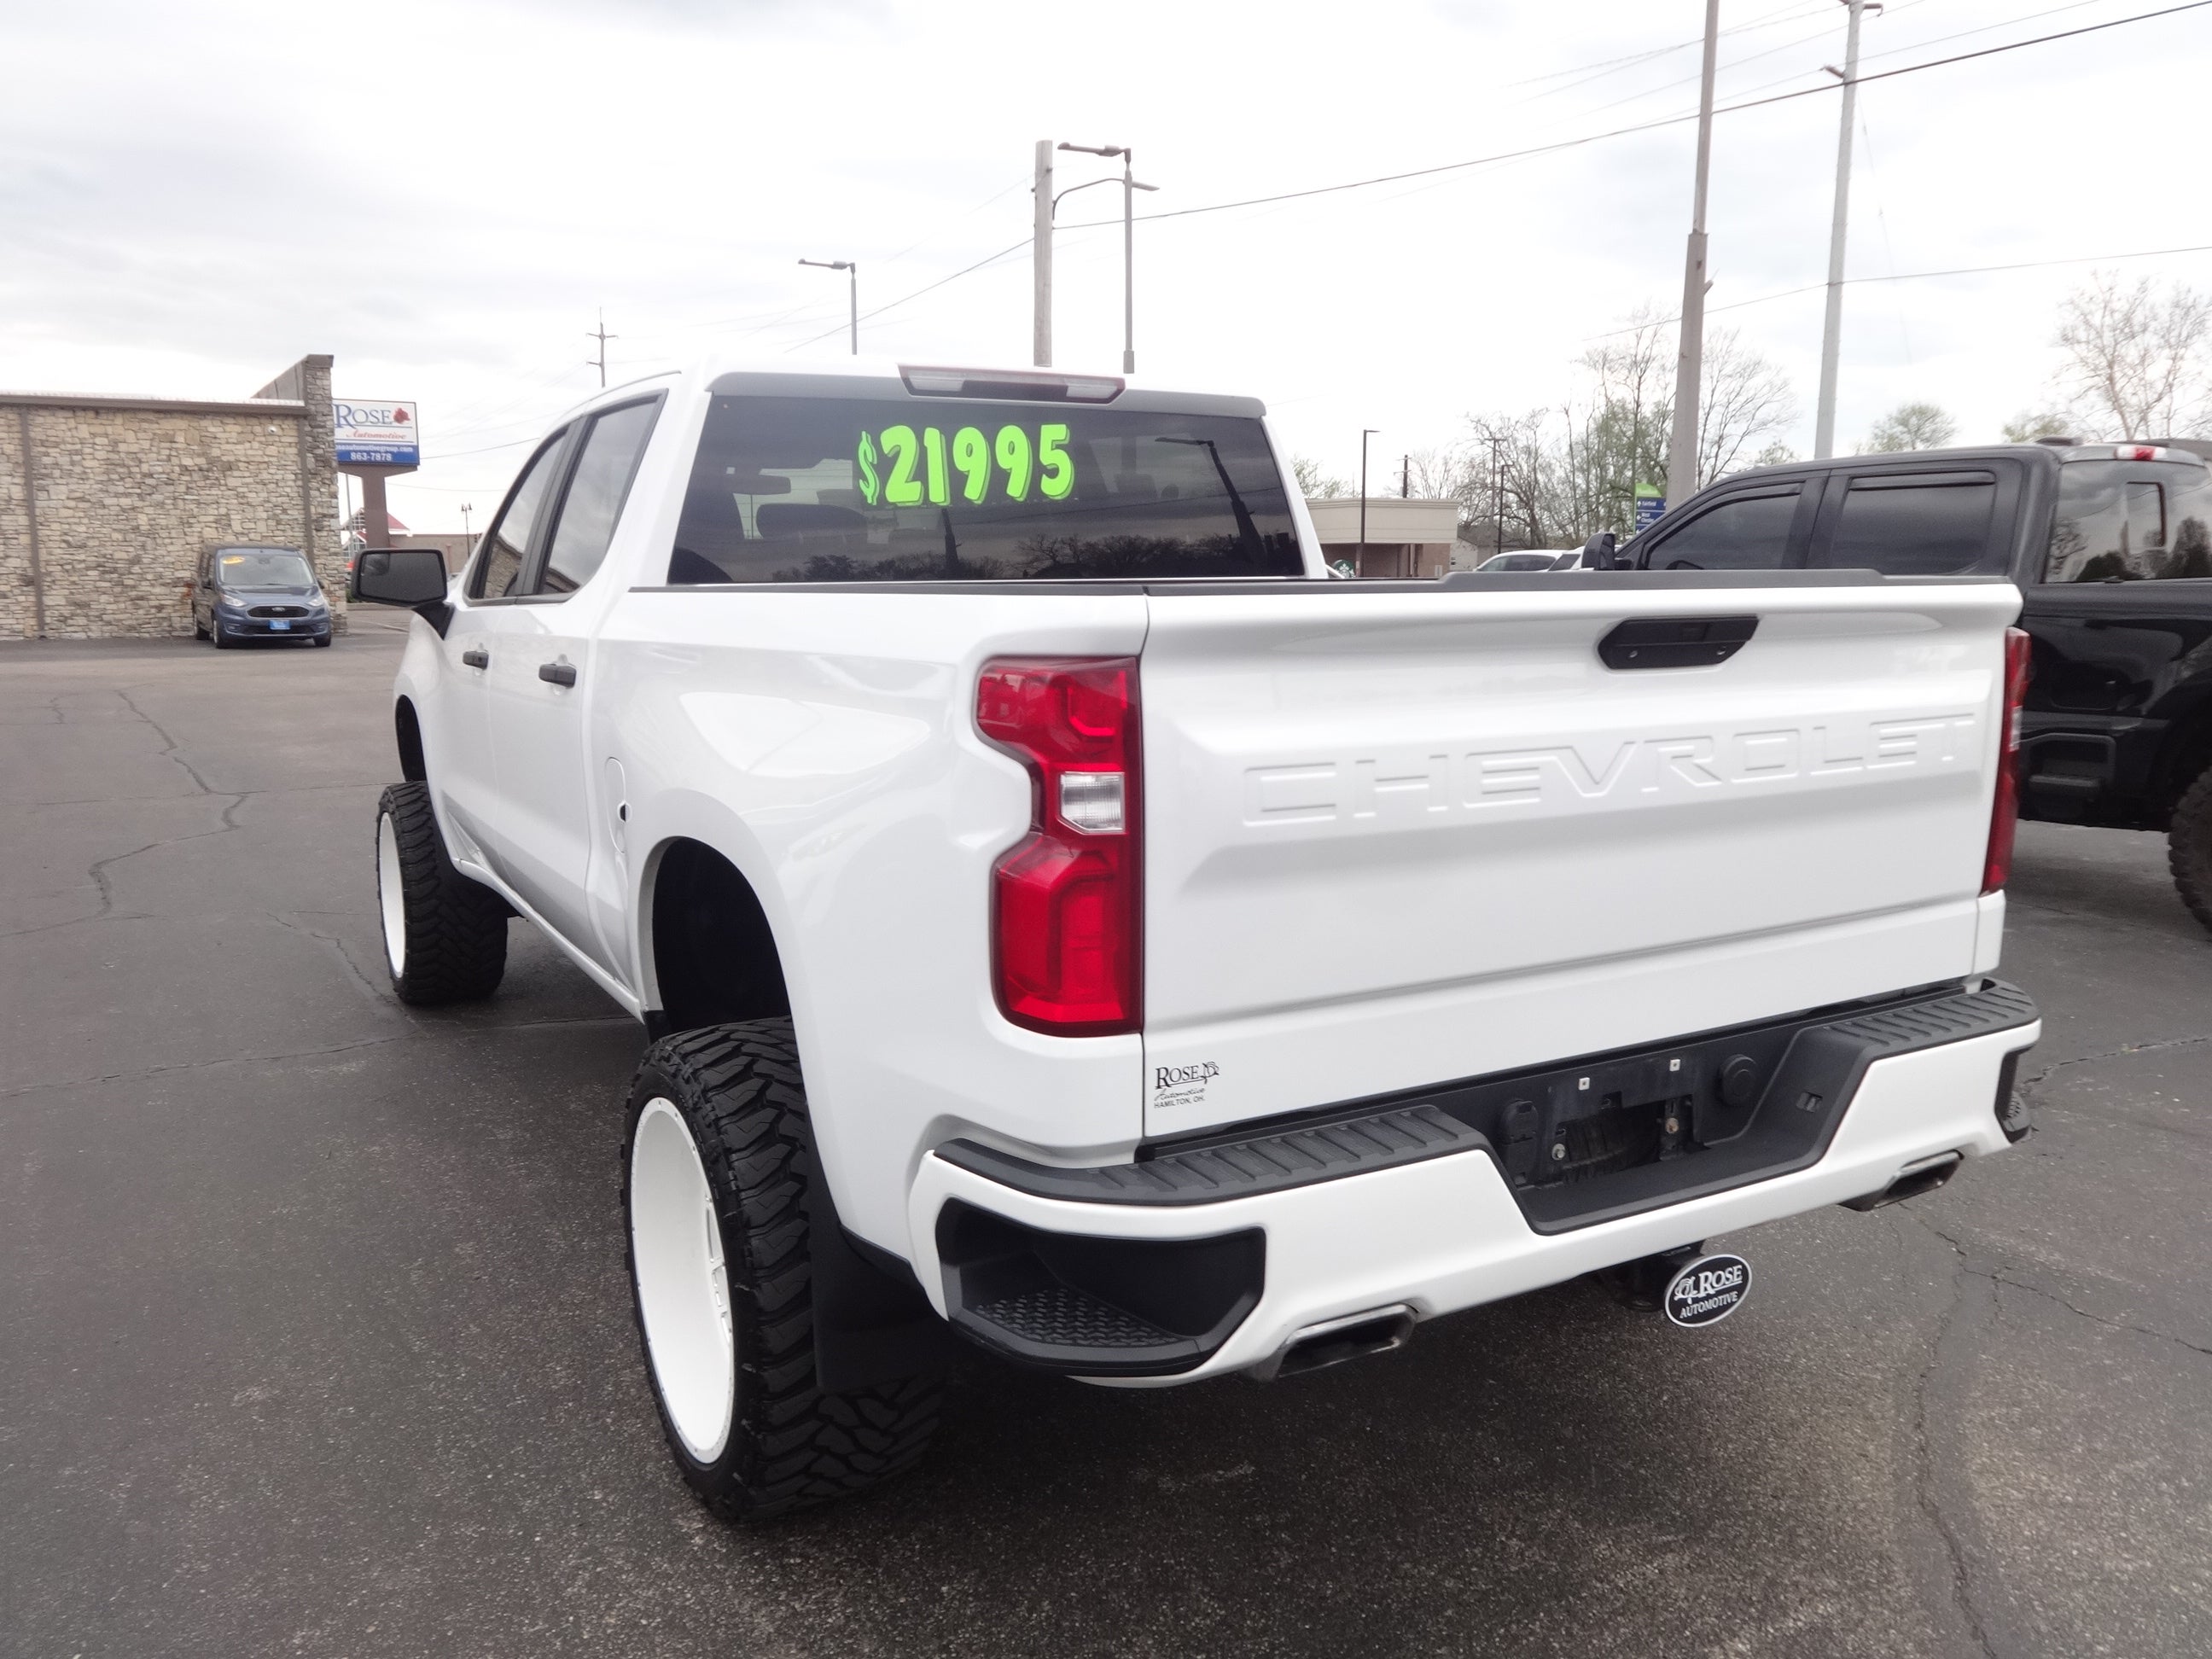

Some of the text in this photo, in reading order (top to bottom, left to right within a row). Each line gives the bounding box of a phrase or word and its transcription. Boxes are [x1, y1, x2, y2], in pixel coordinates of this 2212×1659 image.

[333, 404, 392, 428] ROSE
[351, 452, 392, 461] 863-7878
[858, 423, 1074, 505] $21995
[1243, 712, 1977, 828] CHEVROLET
[1155, 1065, 1198, 1089] ROSE
[1698, 1265, 1743, 1297] ROSE
[1679, 1291, 1738, 1318] AUTOMOTIVE
